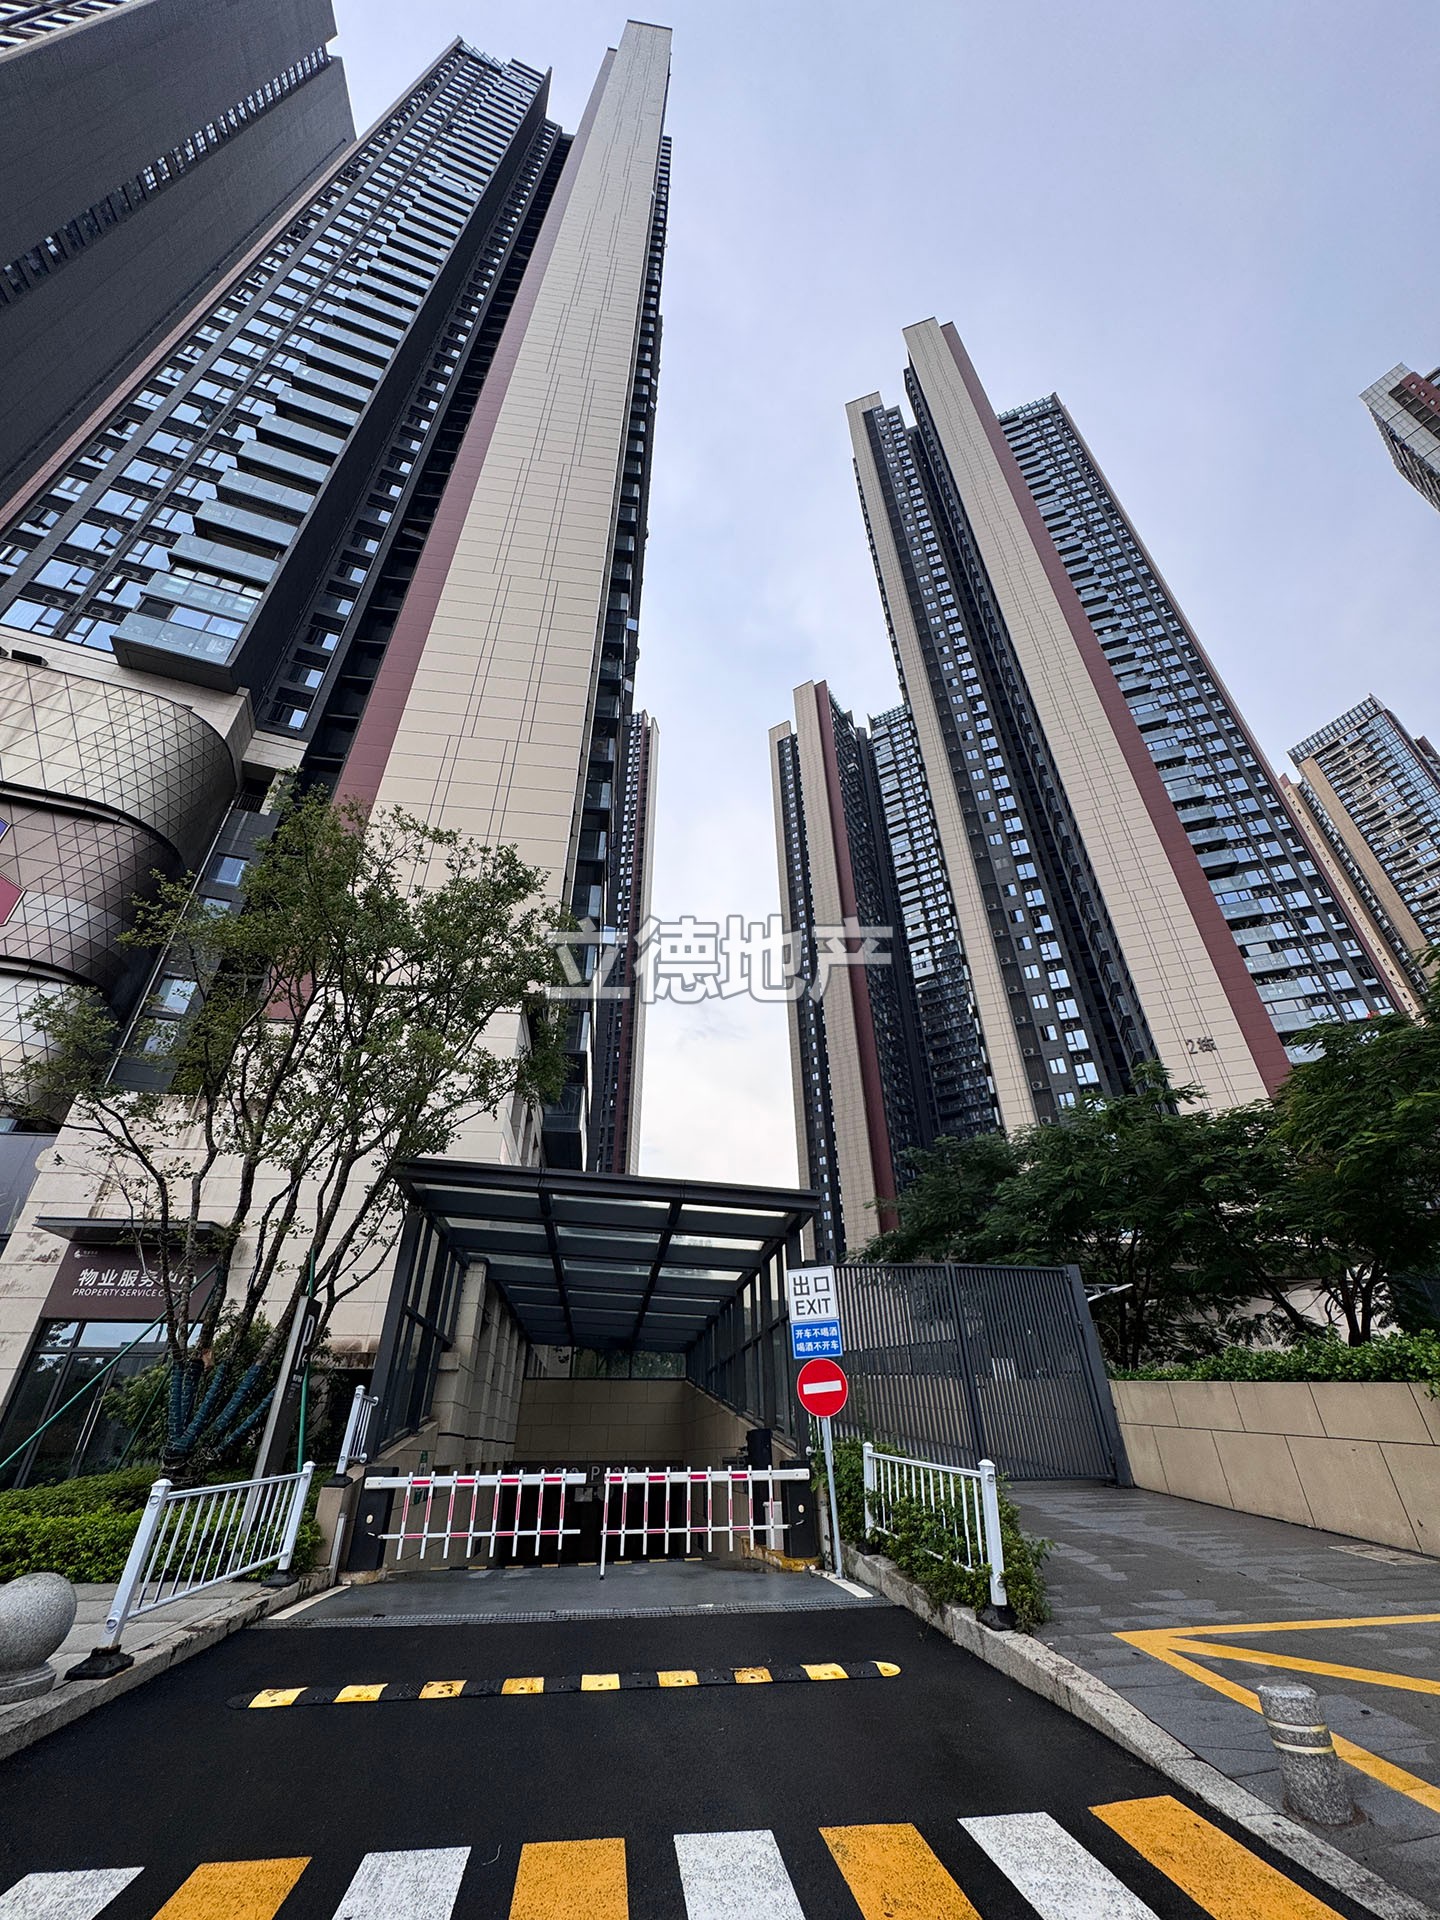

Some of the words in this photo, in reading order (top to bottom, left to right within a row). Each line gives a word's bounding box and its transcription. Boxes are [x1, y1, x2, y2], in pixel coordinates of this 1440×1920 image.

[793, 1275, 830, 1296] 出口
[72, 1288, 120, 1297] PROPERTY
[120, 1288, 157, 1297] SERVICE
[795, 1297, 831, 1316] EXIT
[795, 1327, 838, 1339] 开车不喝酒
[796, 1340, 839, 1352] 喝酒不开车
